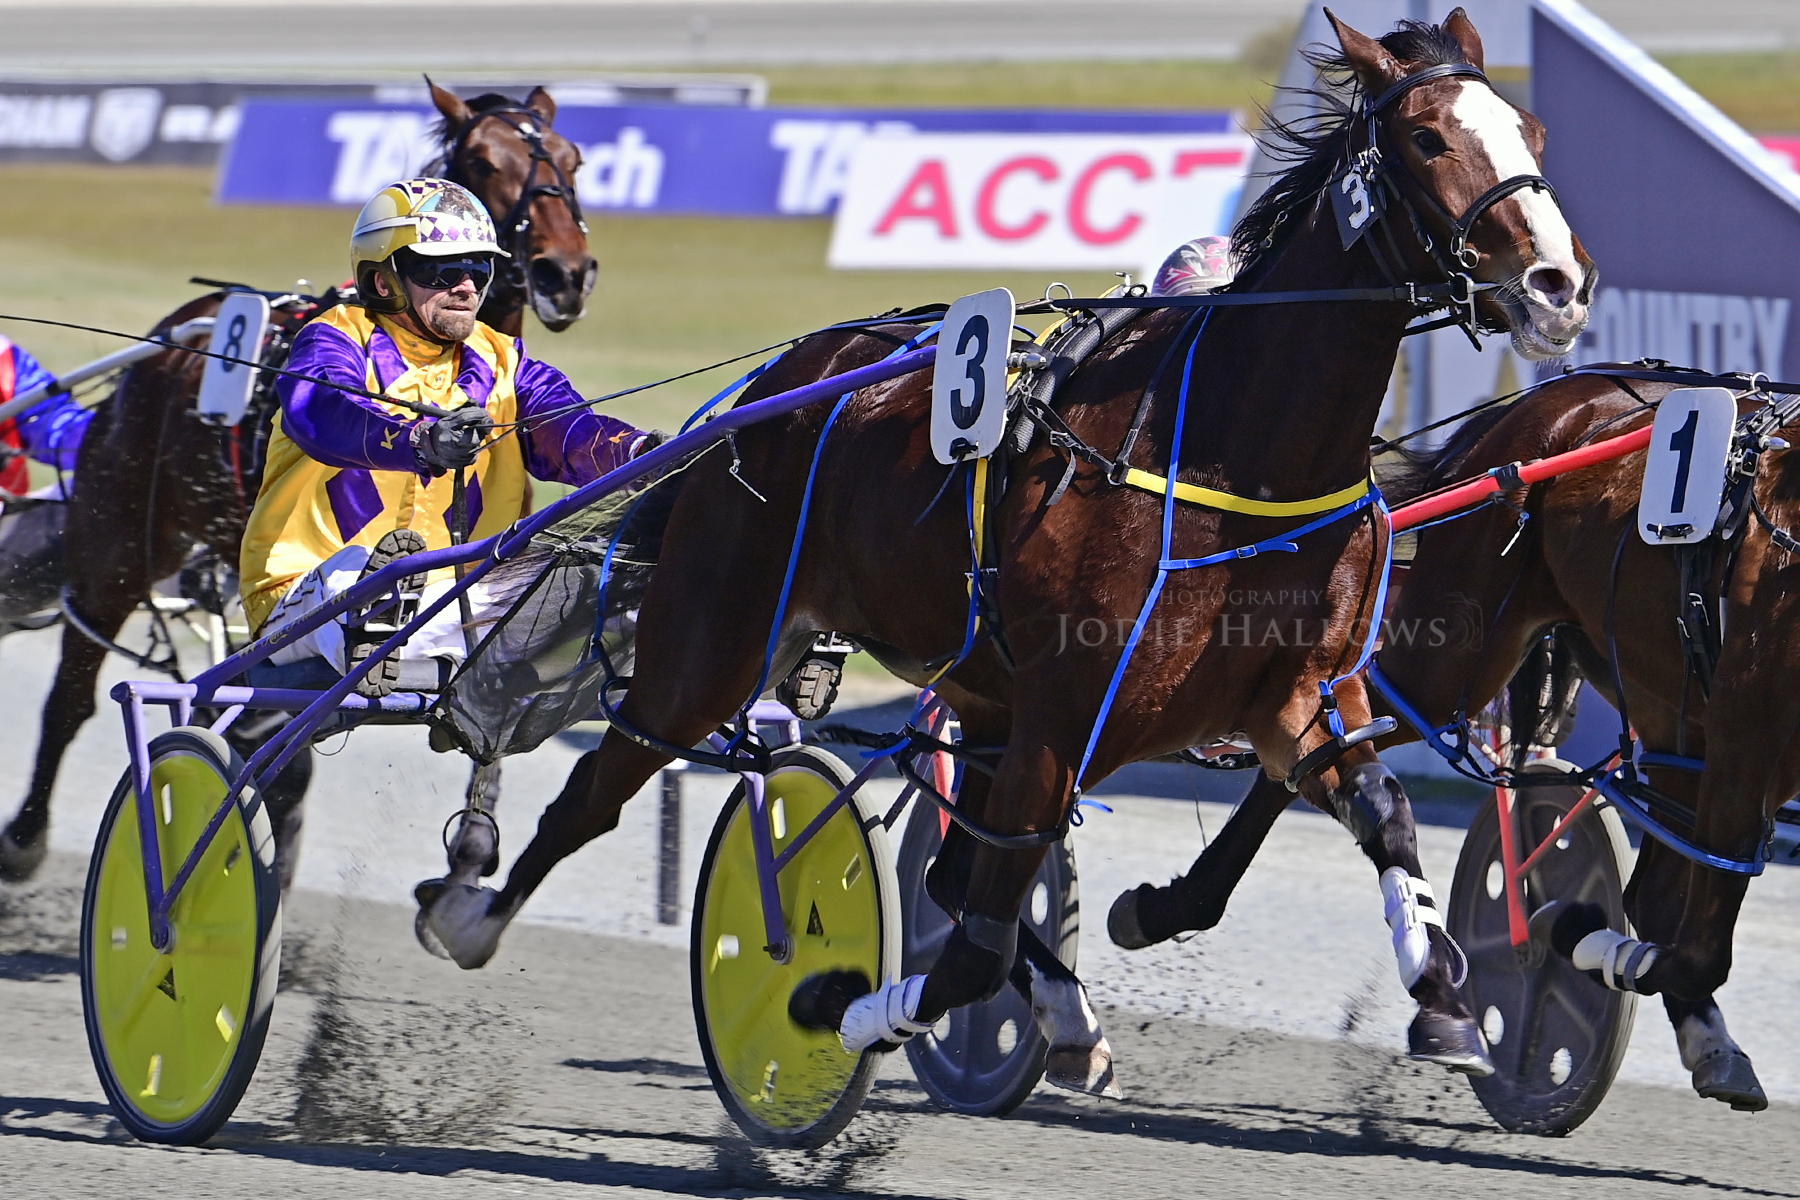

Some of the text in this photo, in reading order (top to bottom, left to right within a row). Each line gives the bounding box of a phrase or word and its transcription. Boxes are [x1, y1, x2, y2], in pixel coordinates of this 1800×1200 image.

[872, 150, 1246, 247] ACC
[1341, 172, 1370, 229] 3
[221, 314, 247, 373] 8
[950, 314, 990, 430] 3
[1669, 409, 1700, 514] 1
